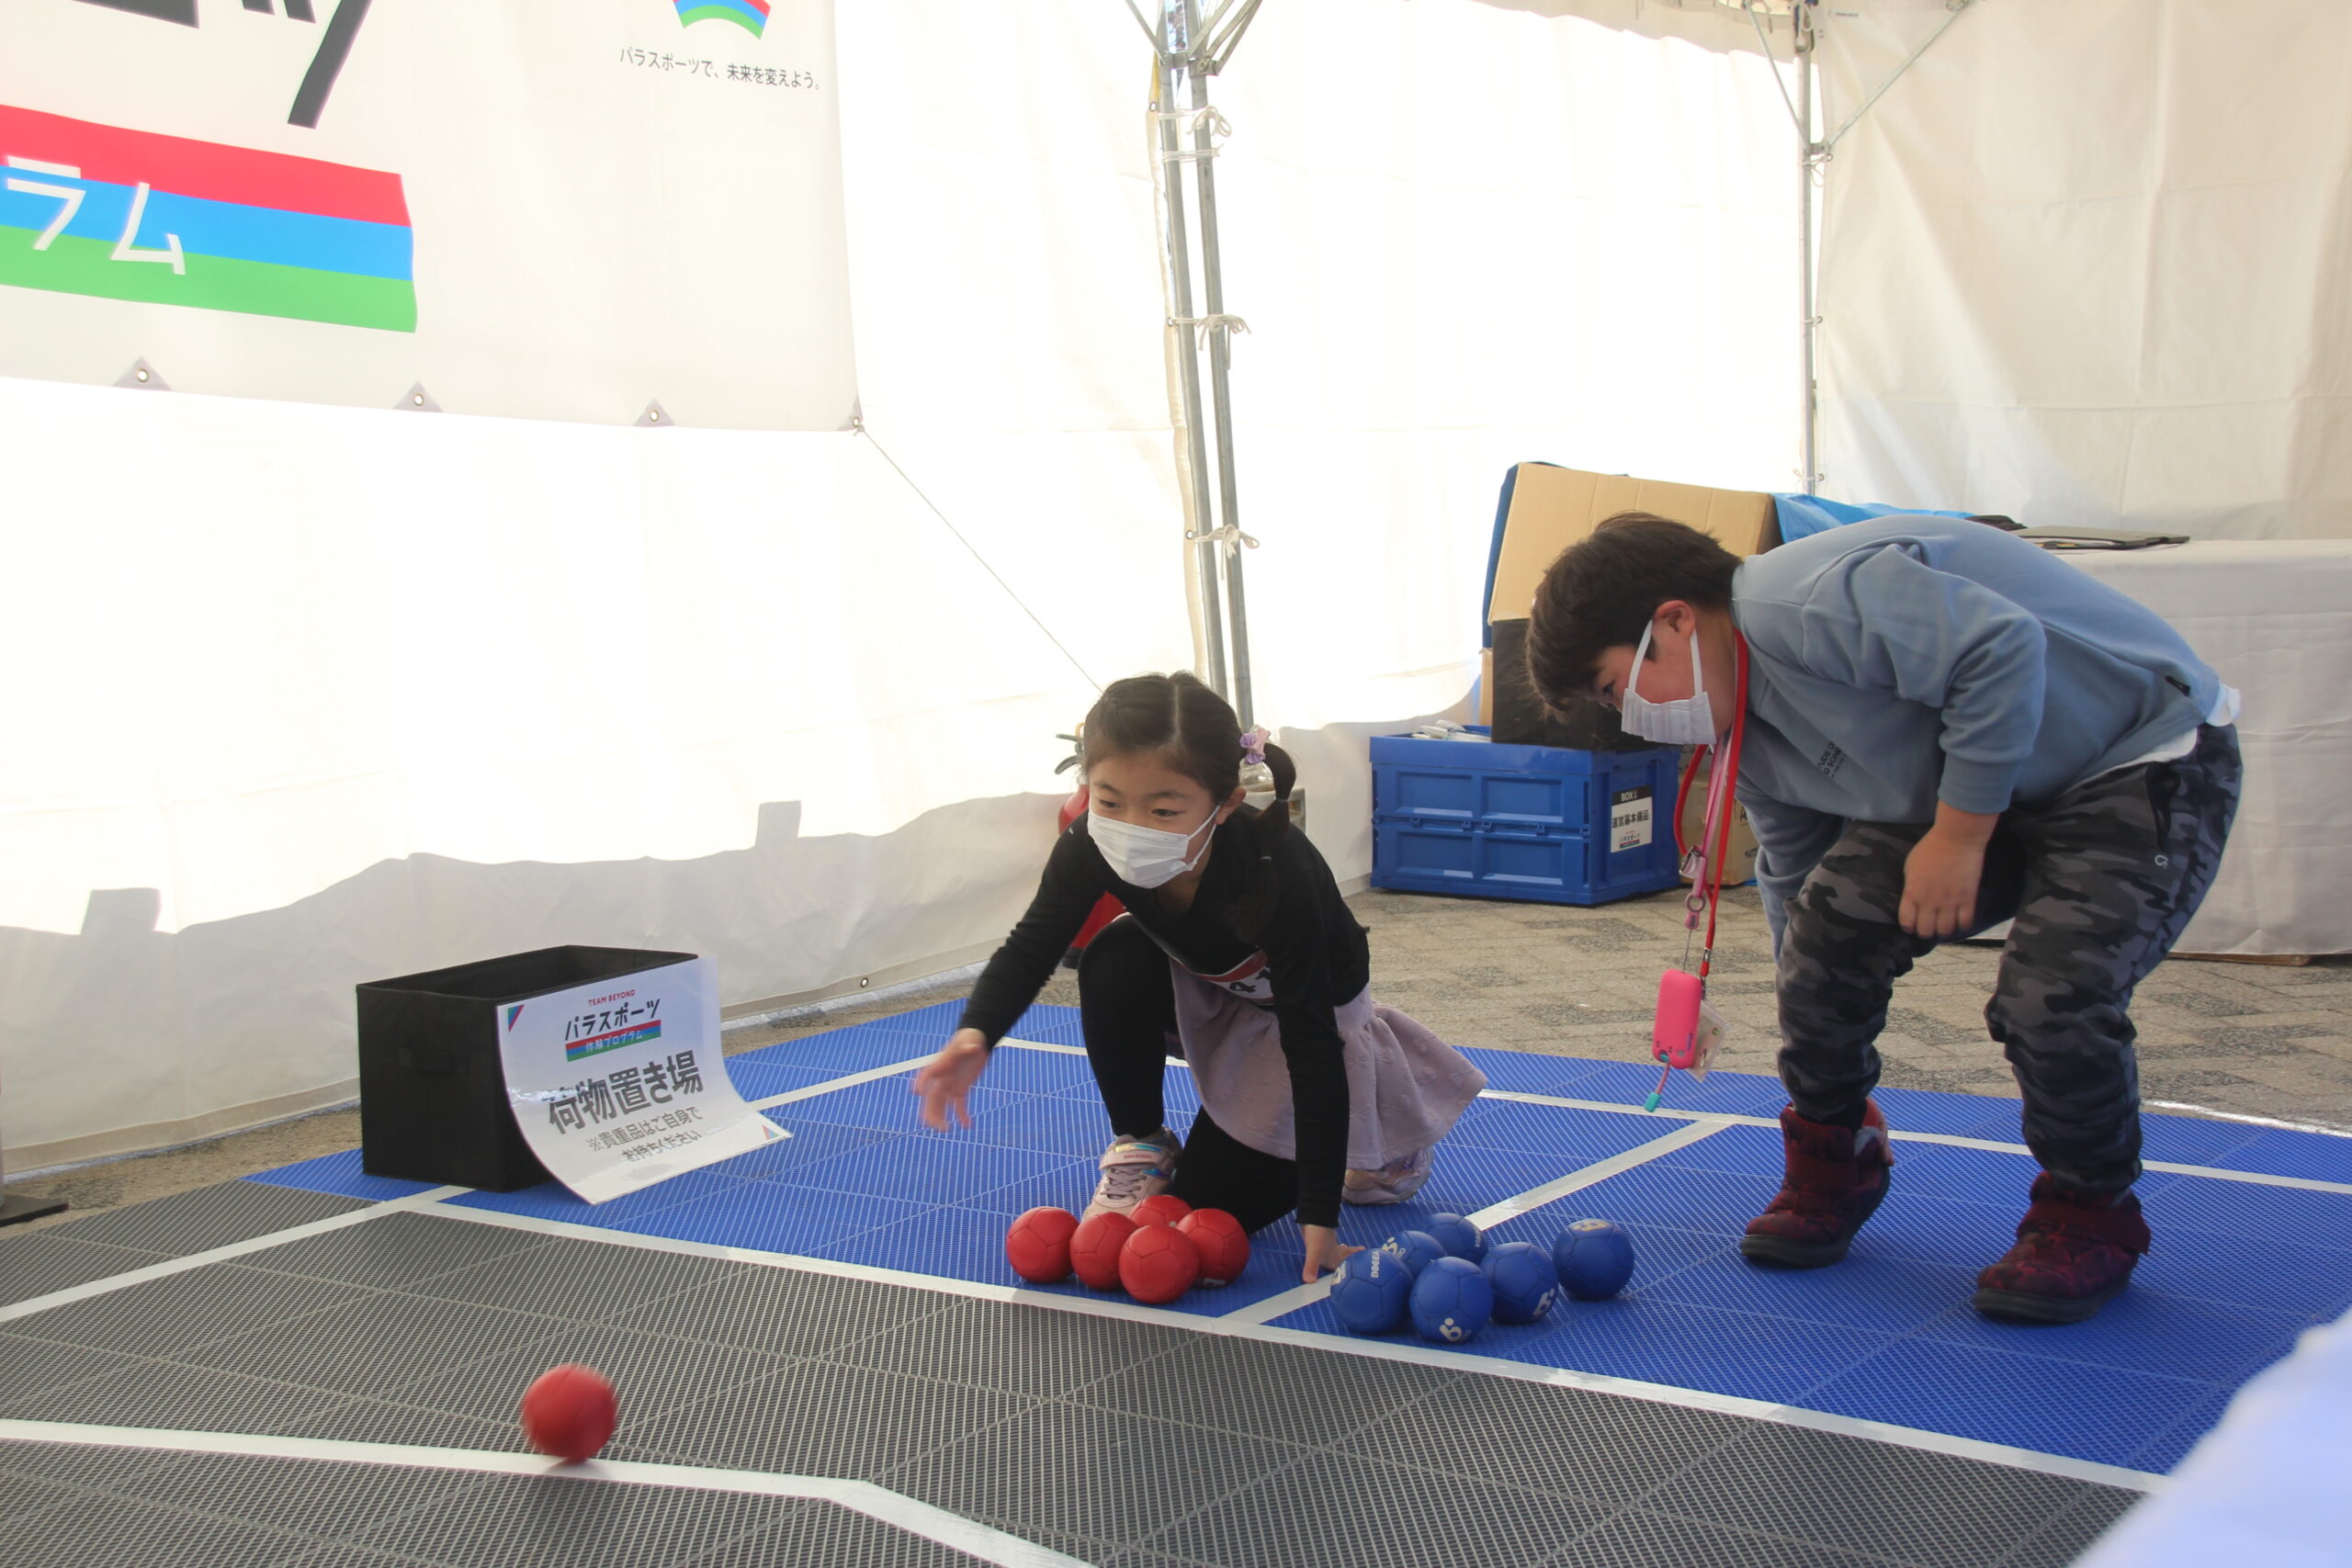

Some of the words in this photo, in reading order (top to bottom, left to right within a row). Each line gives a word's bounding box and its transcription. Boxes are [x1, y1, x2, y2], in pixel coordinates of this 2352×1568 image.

[620, 46, 820, 90] パラスポーツで、未来を変えよう。
[6, 154, 186, 276] ラム
[565, 998, 661, 1041] パラスポーツ
[588, 996, 607, 1007] TEAM
[609, 989, 636, 1002] BEYOND
